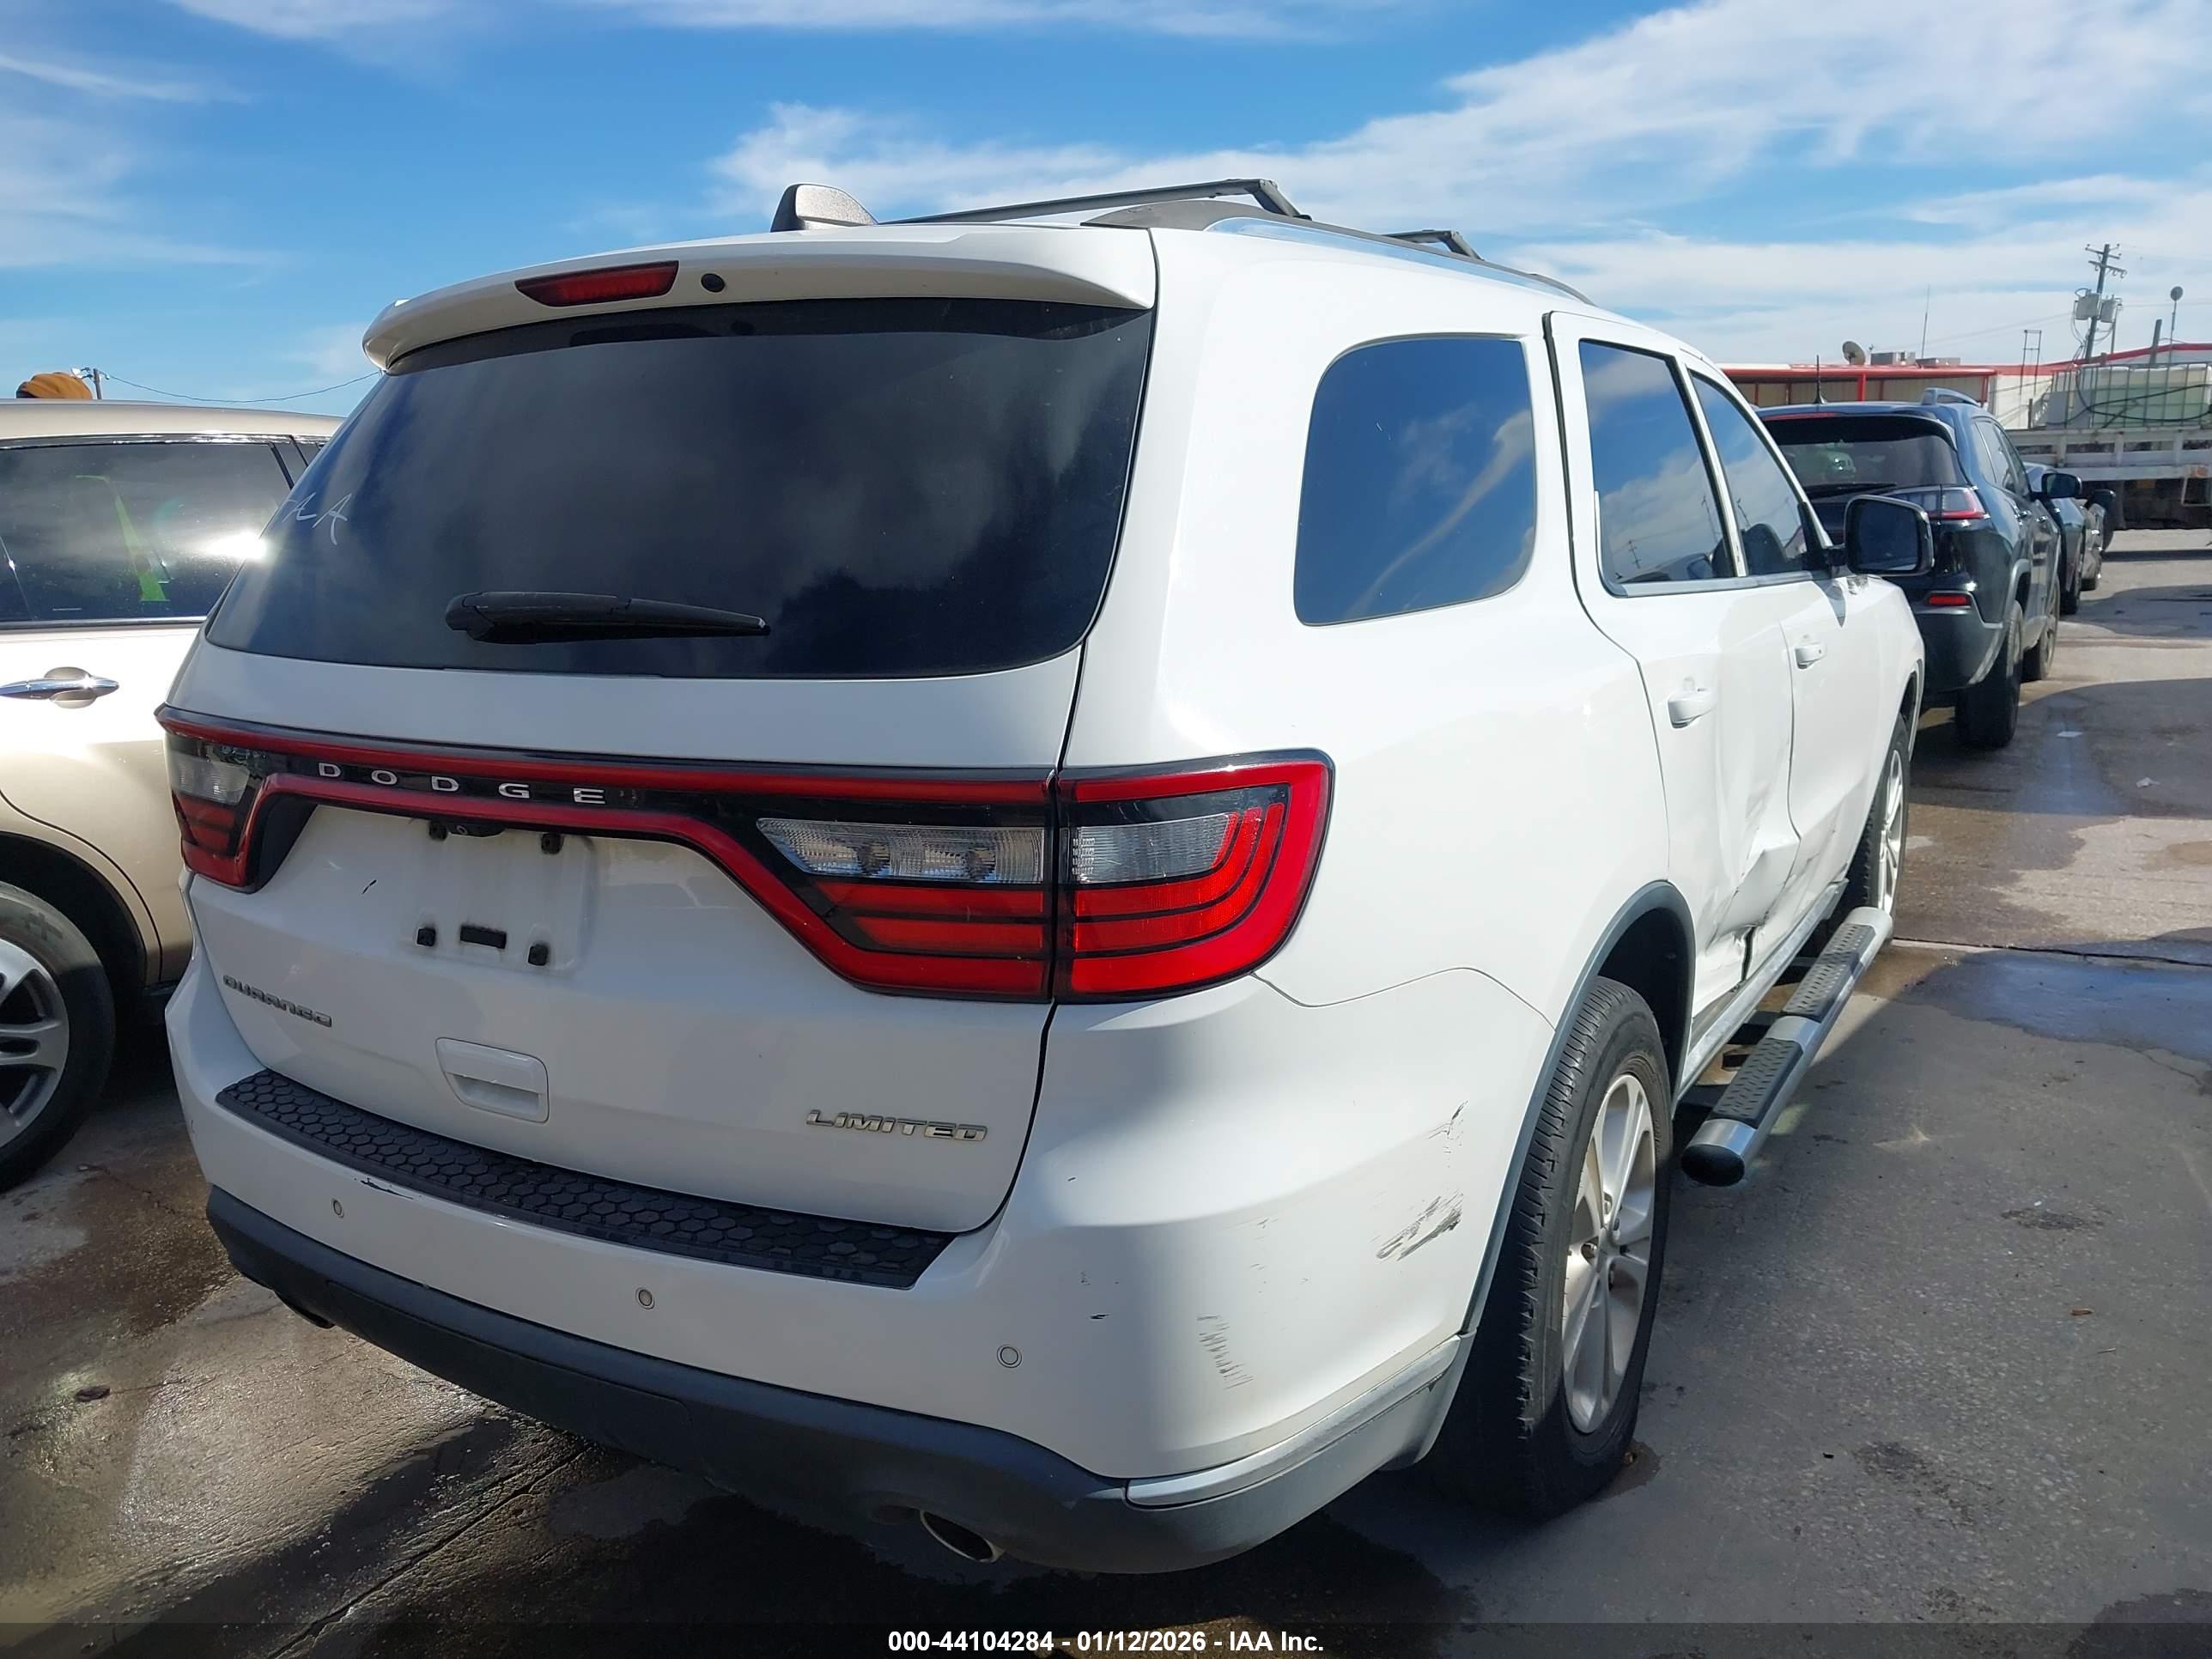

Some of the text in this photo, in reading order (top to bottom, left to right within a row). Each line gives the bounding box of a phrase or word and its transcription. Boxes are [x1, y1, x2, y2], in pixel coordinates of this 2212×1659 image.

[319, 762, 605, 805] DODGE
[223, 975, 332, 1027] DURANGO
[805, 1109, 988, 1141] LIMITED
